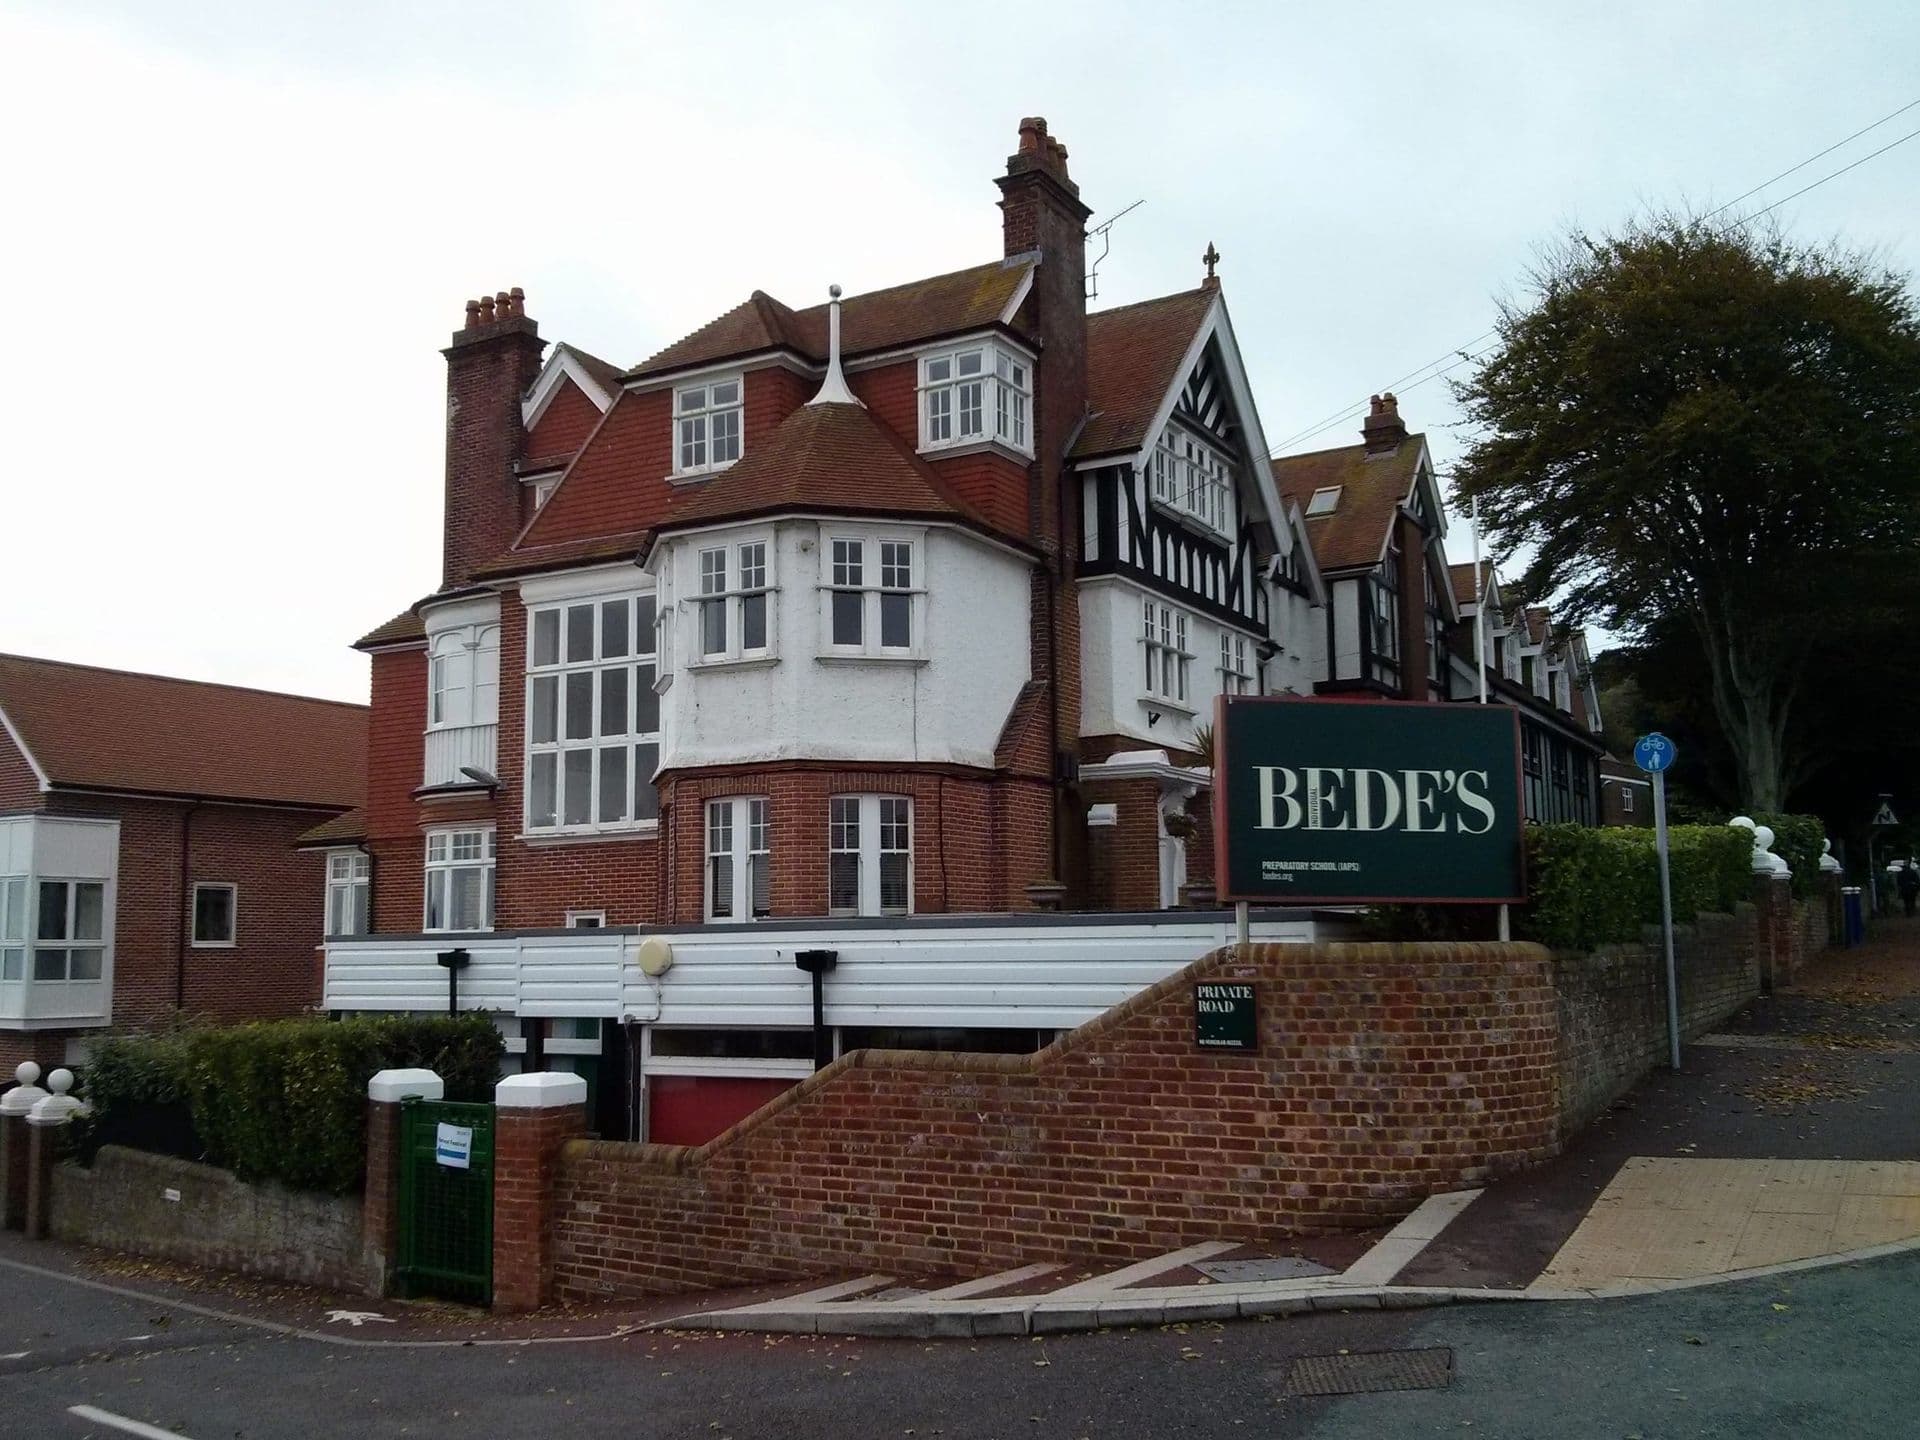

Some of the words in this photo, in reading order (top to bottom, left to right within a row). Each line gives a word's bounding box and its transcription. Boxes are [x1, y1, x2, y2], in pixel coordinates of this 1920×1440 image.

[1252, 766, 1495, 834] BEDE'S
[1310, 787, 1318, 827] INDIVIDUAL
[1262, 861, 1309, 870] PREPARATORY
[1310, 862, 1337, 871] SCHOOL
[1262, 871, 1294, 882] bedes.org
[1198, 986, 1253, 999] PRIVATE
[1198, 1000, 1235, 1013] ROAD
